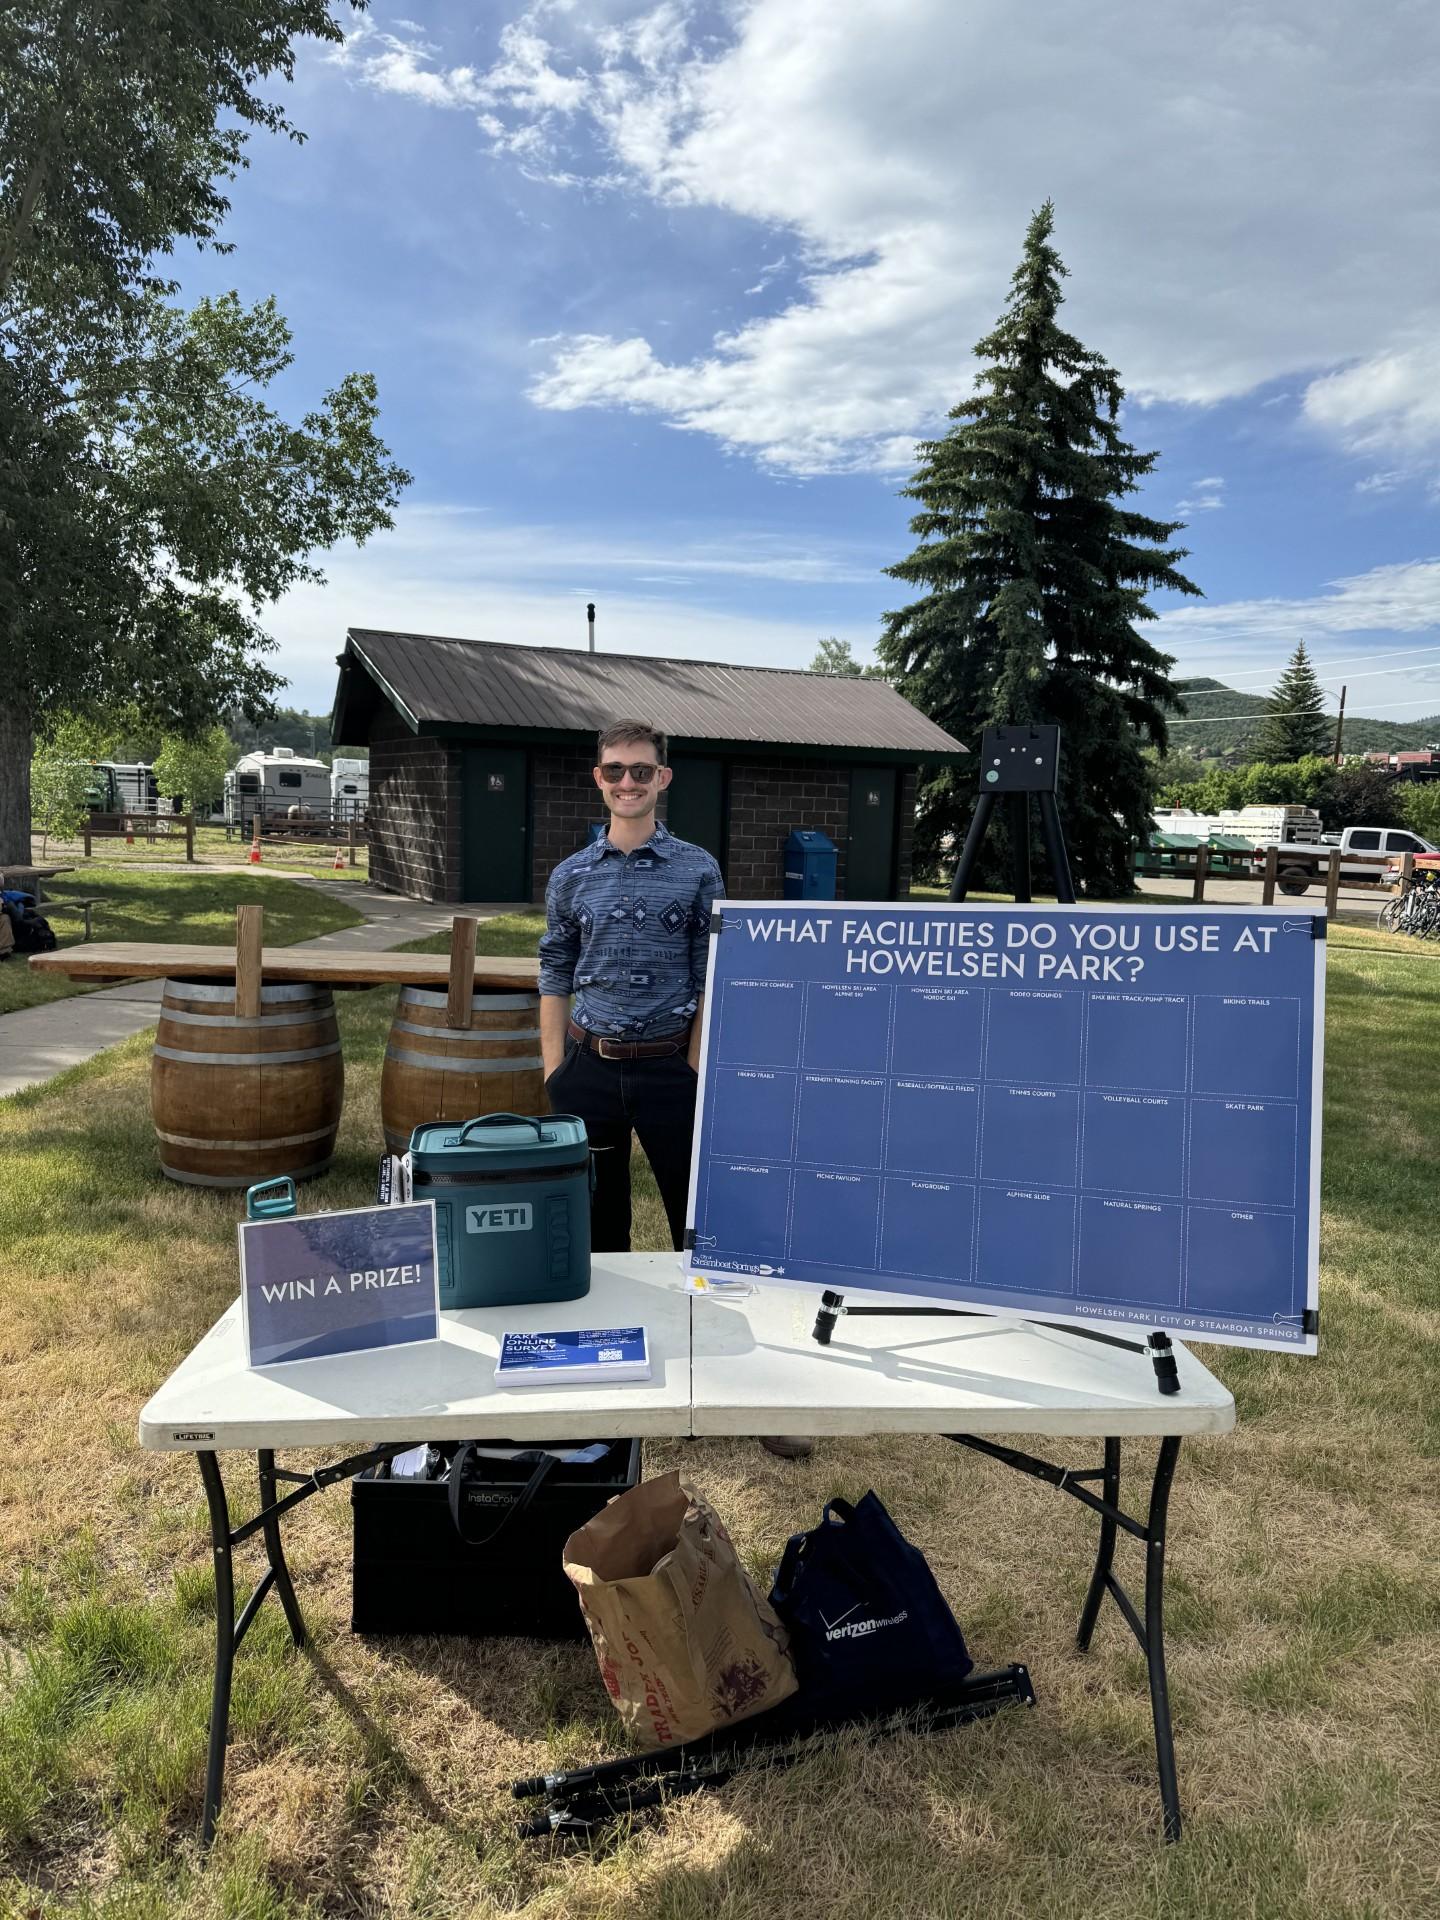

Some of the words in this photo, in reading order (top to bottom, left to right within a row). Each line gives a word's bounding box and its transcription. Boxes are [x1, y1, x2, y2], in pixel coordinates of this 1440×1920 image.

[746, 919, 833, 943] WHAT
[842, 920, 995, 947] FACILITIES
[1006, 923, 1058, 949] DO
[1069, 924, 1141, 952] YOU
[1154, 926, 1220, 953] USE
[1232, 926, 1278, 953] AT
[846, 949, 1024, 980] HOWELSEN
[1038, 954, 1145, 983] PARK?
[1122, 995, 1163, 1003] TRACK/PUMP
[897, 1082, 955, 1091] BASEBALL/SOFTBALL
[1103, 1095, 1142, 1104] VOLLEYBALL
[1142, 1097, 1168, 1105] COURTS
[730, 1165, 769, 1174] AMPHITHEATER
[911, 1182, 950, 1191] PLAYGROUND
[1103, 1201, 1132, 1209] NATURAL
[1133, 1203, 1162, 1212] SPRINGS
[471, 1208, 526, 1228] YETI
[692, 1256, 731, 1269] Steamboat
[732, 1261, 760, 1274] Springs
[261, 1278, 315, 1304] WIN
[324, 1275, 342, 1296] A
[350, 1264, 421, 1292] PRIZE!
[1075, 1305, 1125, 1318] HOWELSEN
[1128, 1311, 1151, 1321] PARK
[1160, 1315, 1181, 1325] CITY
[1183, 1318, 1196, 1326] OF
[1199, 1320, 1254, 1334] STEAMBOAT
[1257, 1327, 1299, 1340] SPRINGS
[505, 1343, 557, 1351] SURVEY
[825, 1618, 877, 1642] verizon
